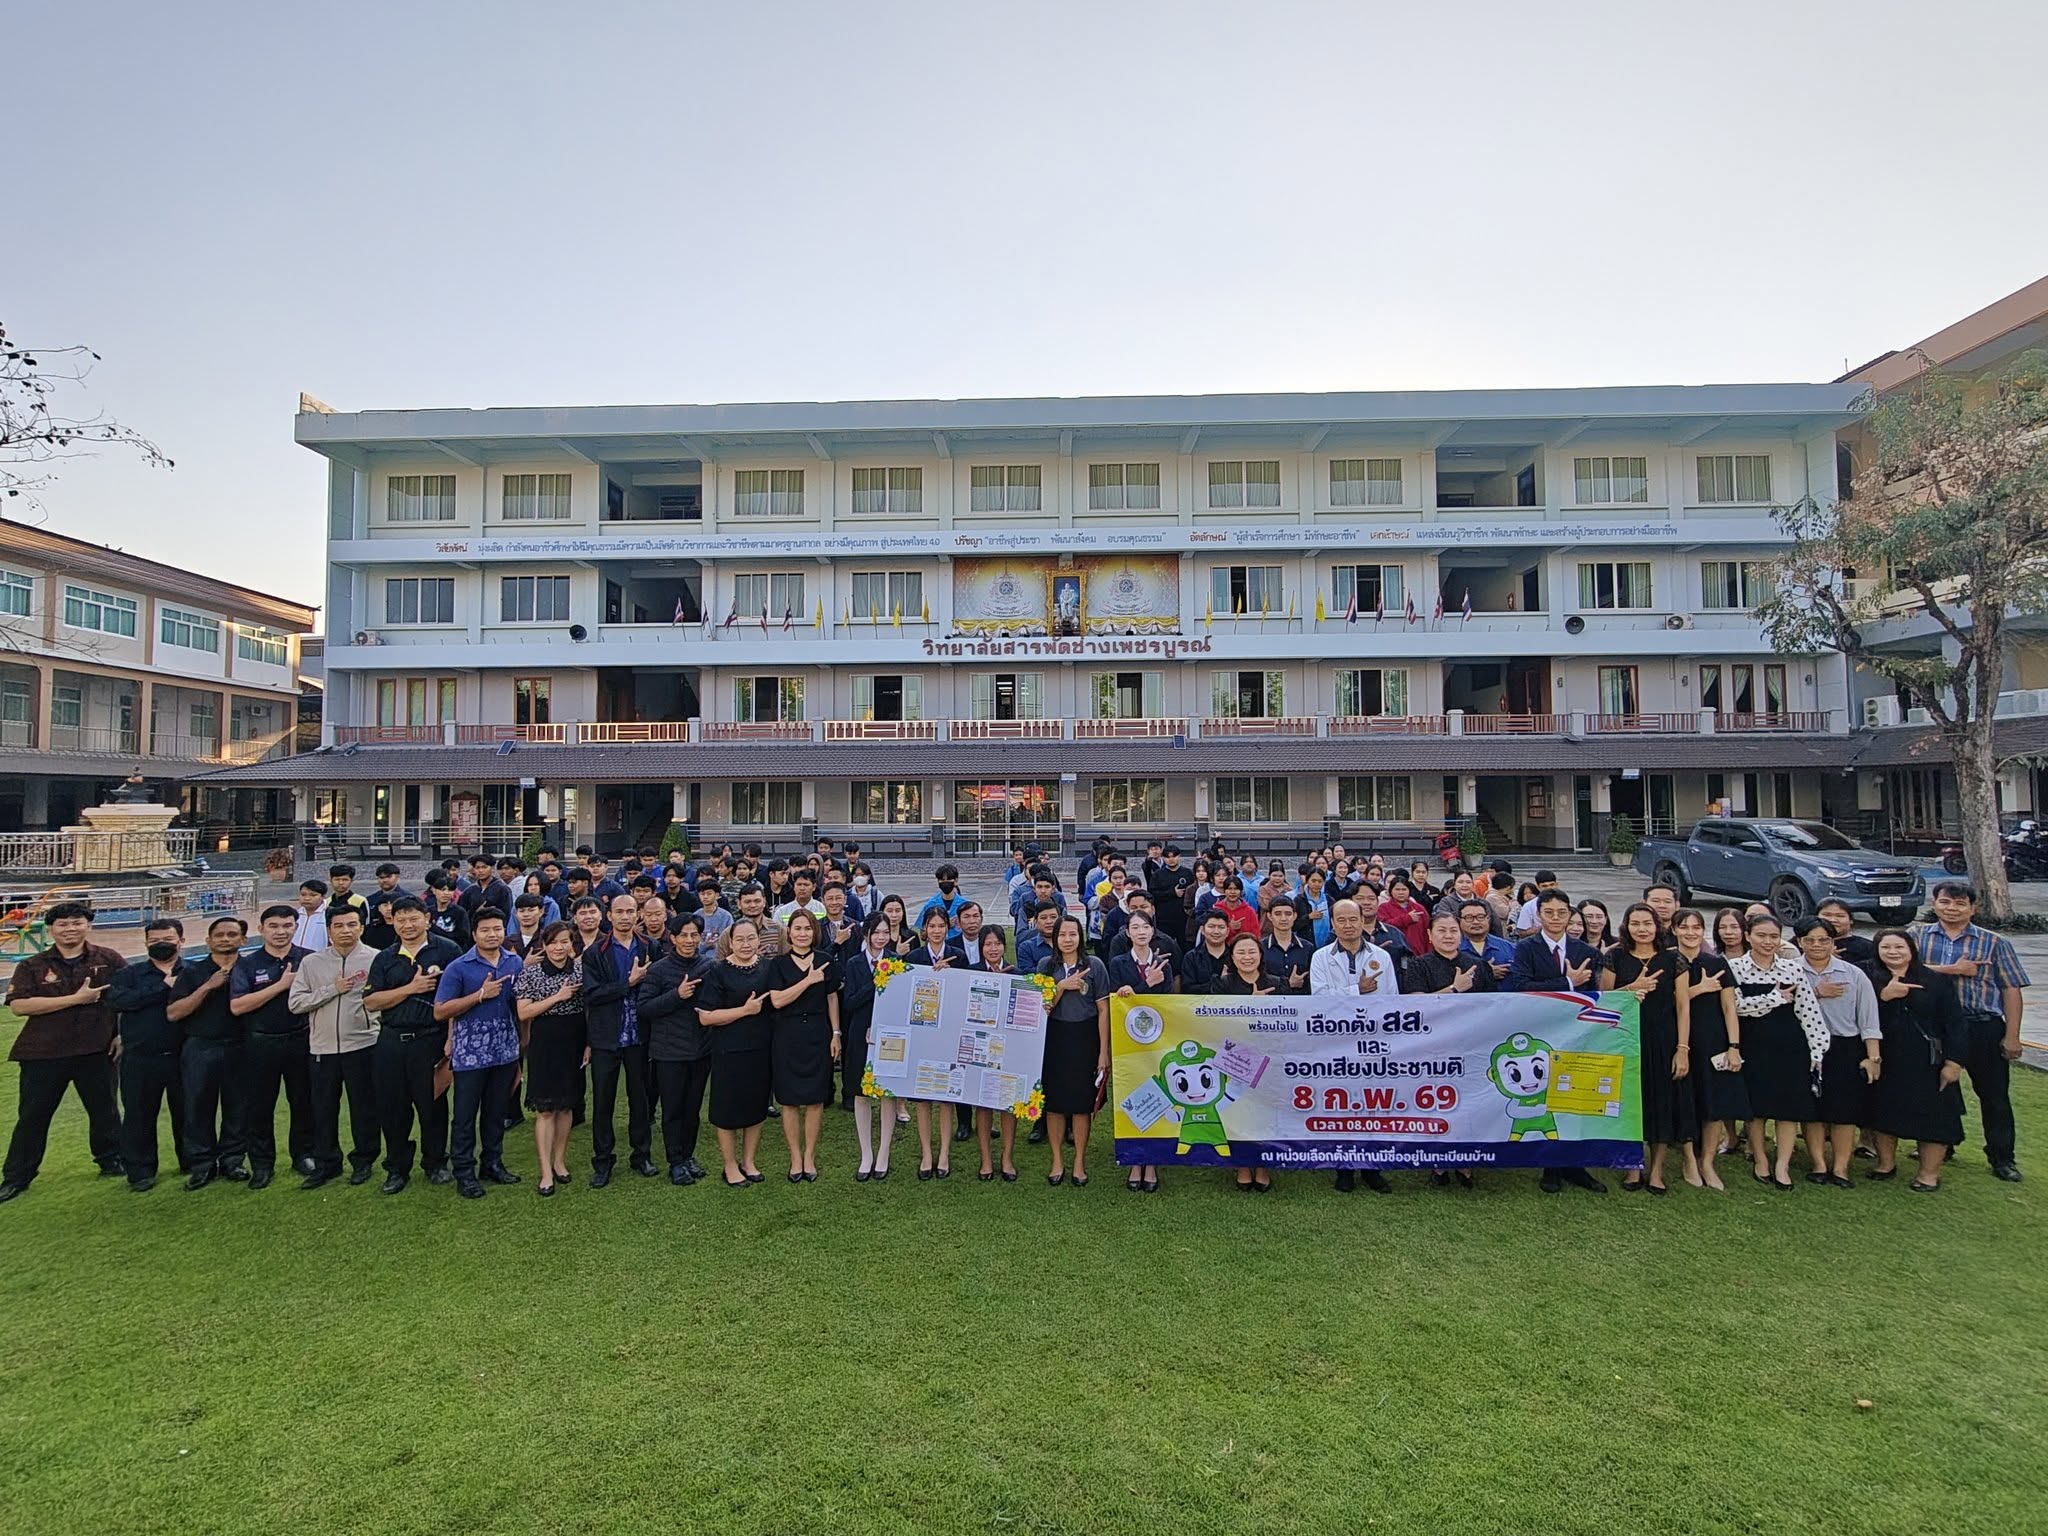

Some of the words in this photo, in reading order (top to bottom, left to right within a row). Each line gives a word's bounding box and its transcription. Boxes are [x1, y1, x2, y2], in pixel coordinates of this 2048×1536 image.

[955, 534, 983, 549] ปรัชญา
[1189, 530, 1228, 542] อัตลักษณ์
[922, 635, 1212, 659] วิทยาลัยสารพัดช่างเพชรบูรณ์
[1194, 1004, 1297, 1016] สร้างสรรค์ประเทศไทย
[1248, 1020, 1297, 1031] พร้อมใจไป
[1305, 1008, 1376, 1034] เลือกตั้ง
[1382, 1010, 1430, 1032] สส.
[1357, 1040, 1389, 1054] และ
[1284, 1056, 1463, 1077] ออกเสียงประชามติ
[1293, 1085, 1314, 1110] 8
[1323, 1087, 1406, 1110] ก.พ.
[1414, 1085, 1457, 1110] 69
[1191, 1113, 1207, 1121] ECT
[1313, 1120, 1344, 1131] เวลา
[1427, 1121, 1444, 1132] น.
[1261, 1152, 1274, 1162] ณ
[1276, 1144, 1496, 1167] หน่วยเลือกตั้งที่ท่านมีชื่ออยู่ในทะเบียนบ้าน
